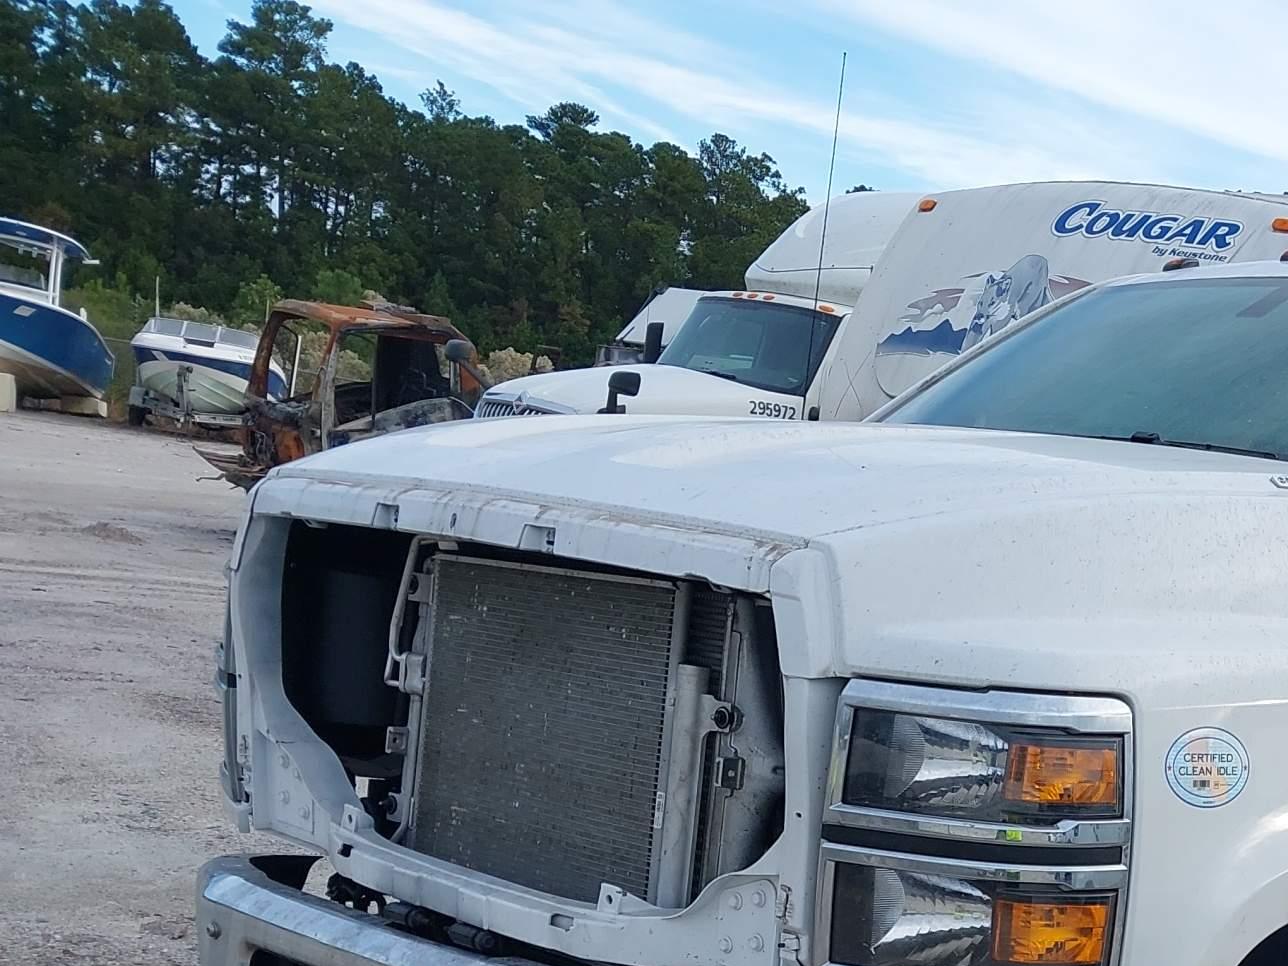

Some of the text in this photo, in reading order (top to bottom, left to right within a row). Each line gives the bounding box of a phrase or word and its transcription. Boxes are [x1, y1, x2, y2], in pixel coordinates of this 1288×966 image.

[1052, 201, 1243, 251] COUGAR
[1152, 246, 1168, 257] by
[749, 400, 797, 420] 295972
[1183, 753, 1234, 763] CERTIFIED
[1178, 766, 1238, 776] CLEAN IDLE
